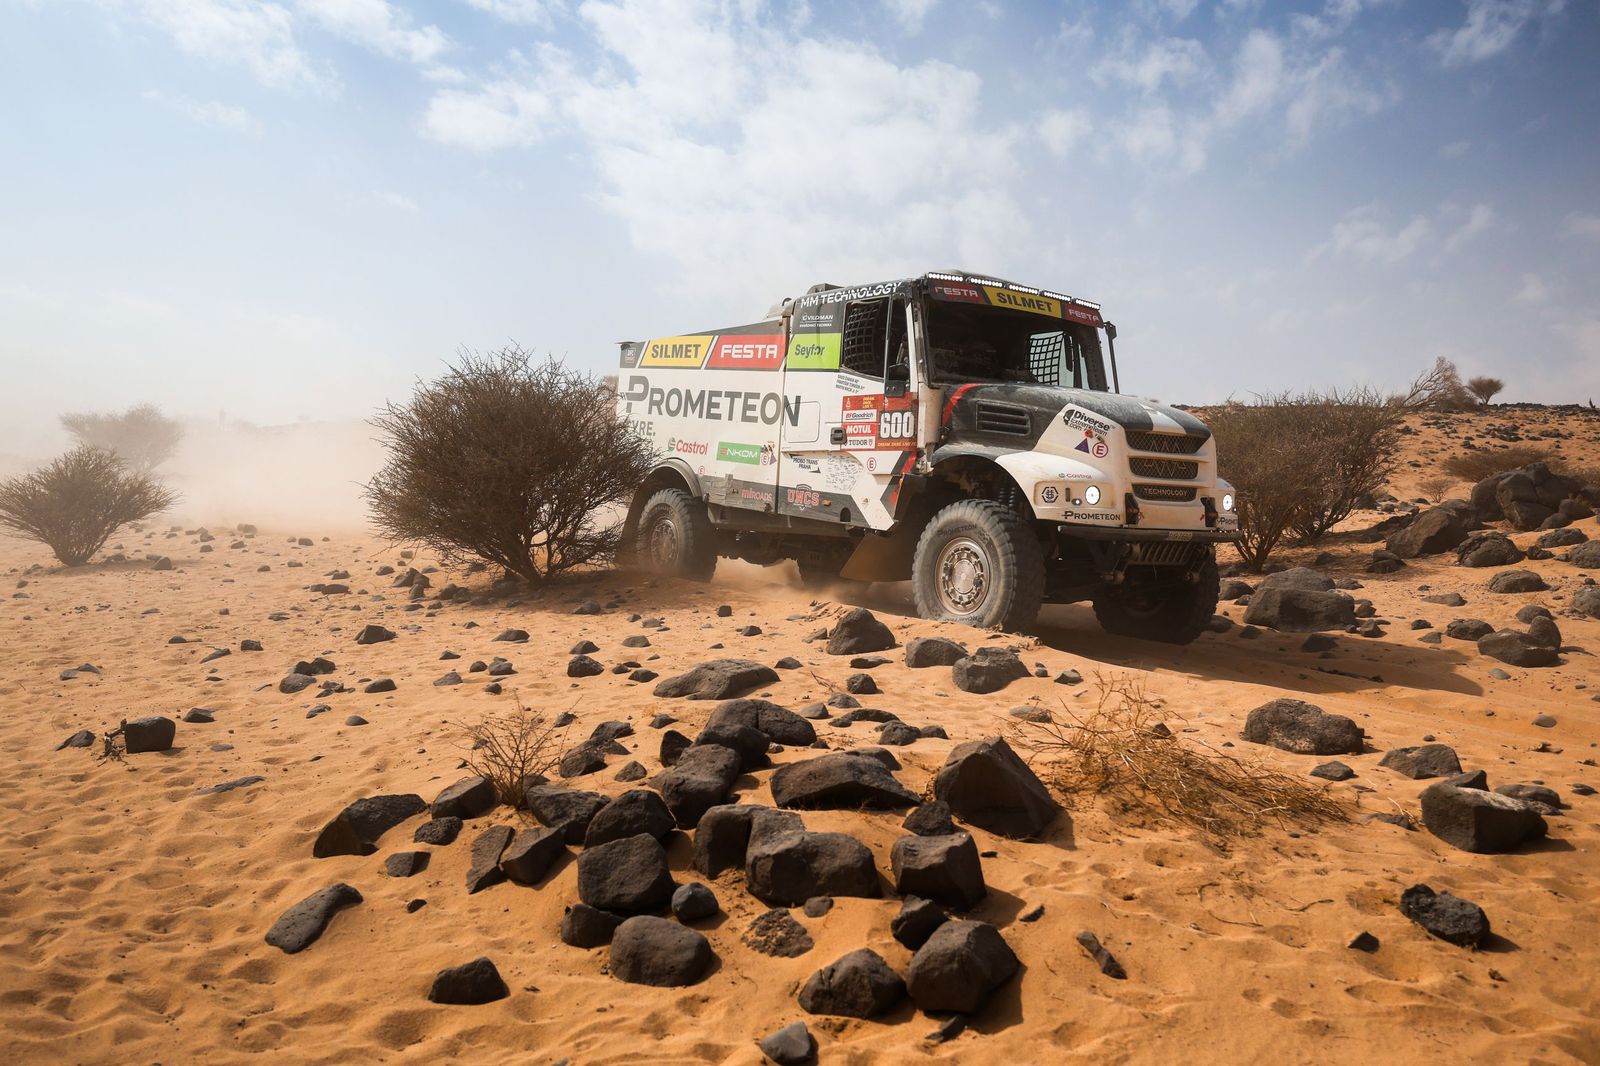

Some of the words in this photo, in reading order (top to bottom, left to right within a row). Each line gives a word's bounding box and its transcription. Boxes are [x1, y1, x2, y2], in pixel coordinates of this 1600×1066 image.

[800, 295, 819, 308] MM
[820, 281, 903, 304] TECHNOLOGY
[934, 286, 978, 298] FESTA
[996, 292, 1053, 313] SILMET
[1068, 308, 1099, 321] FESTA
[651, 343, 702, 359] SILMET
[720, 343, 778, 359] FESTA
[794, 344, 825, 358] Seyfor
[624, 375, 802, 427] PROMETEON
[626, 420, 656, 437] YRE.
[846, 424, 872, 434] MOTUL
[880, 411, 915, 439] 600
[1074, 410, 1110, 432] Diverse
[675, 439, 709, 456] Castrol
[1143, 488, 1188, 497] TECHNOLOGY
[1062, 510, 1121, 521] PROMETEON
